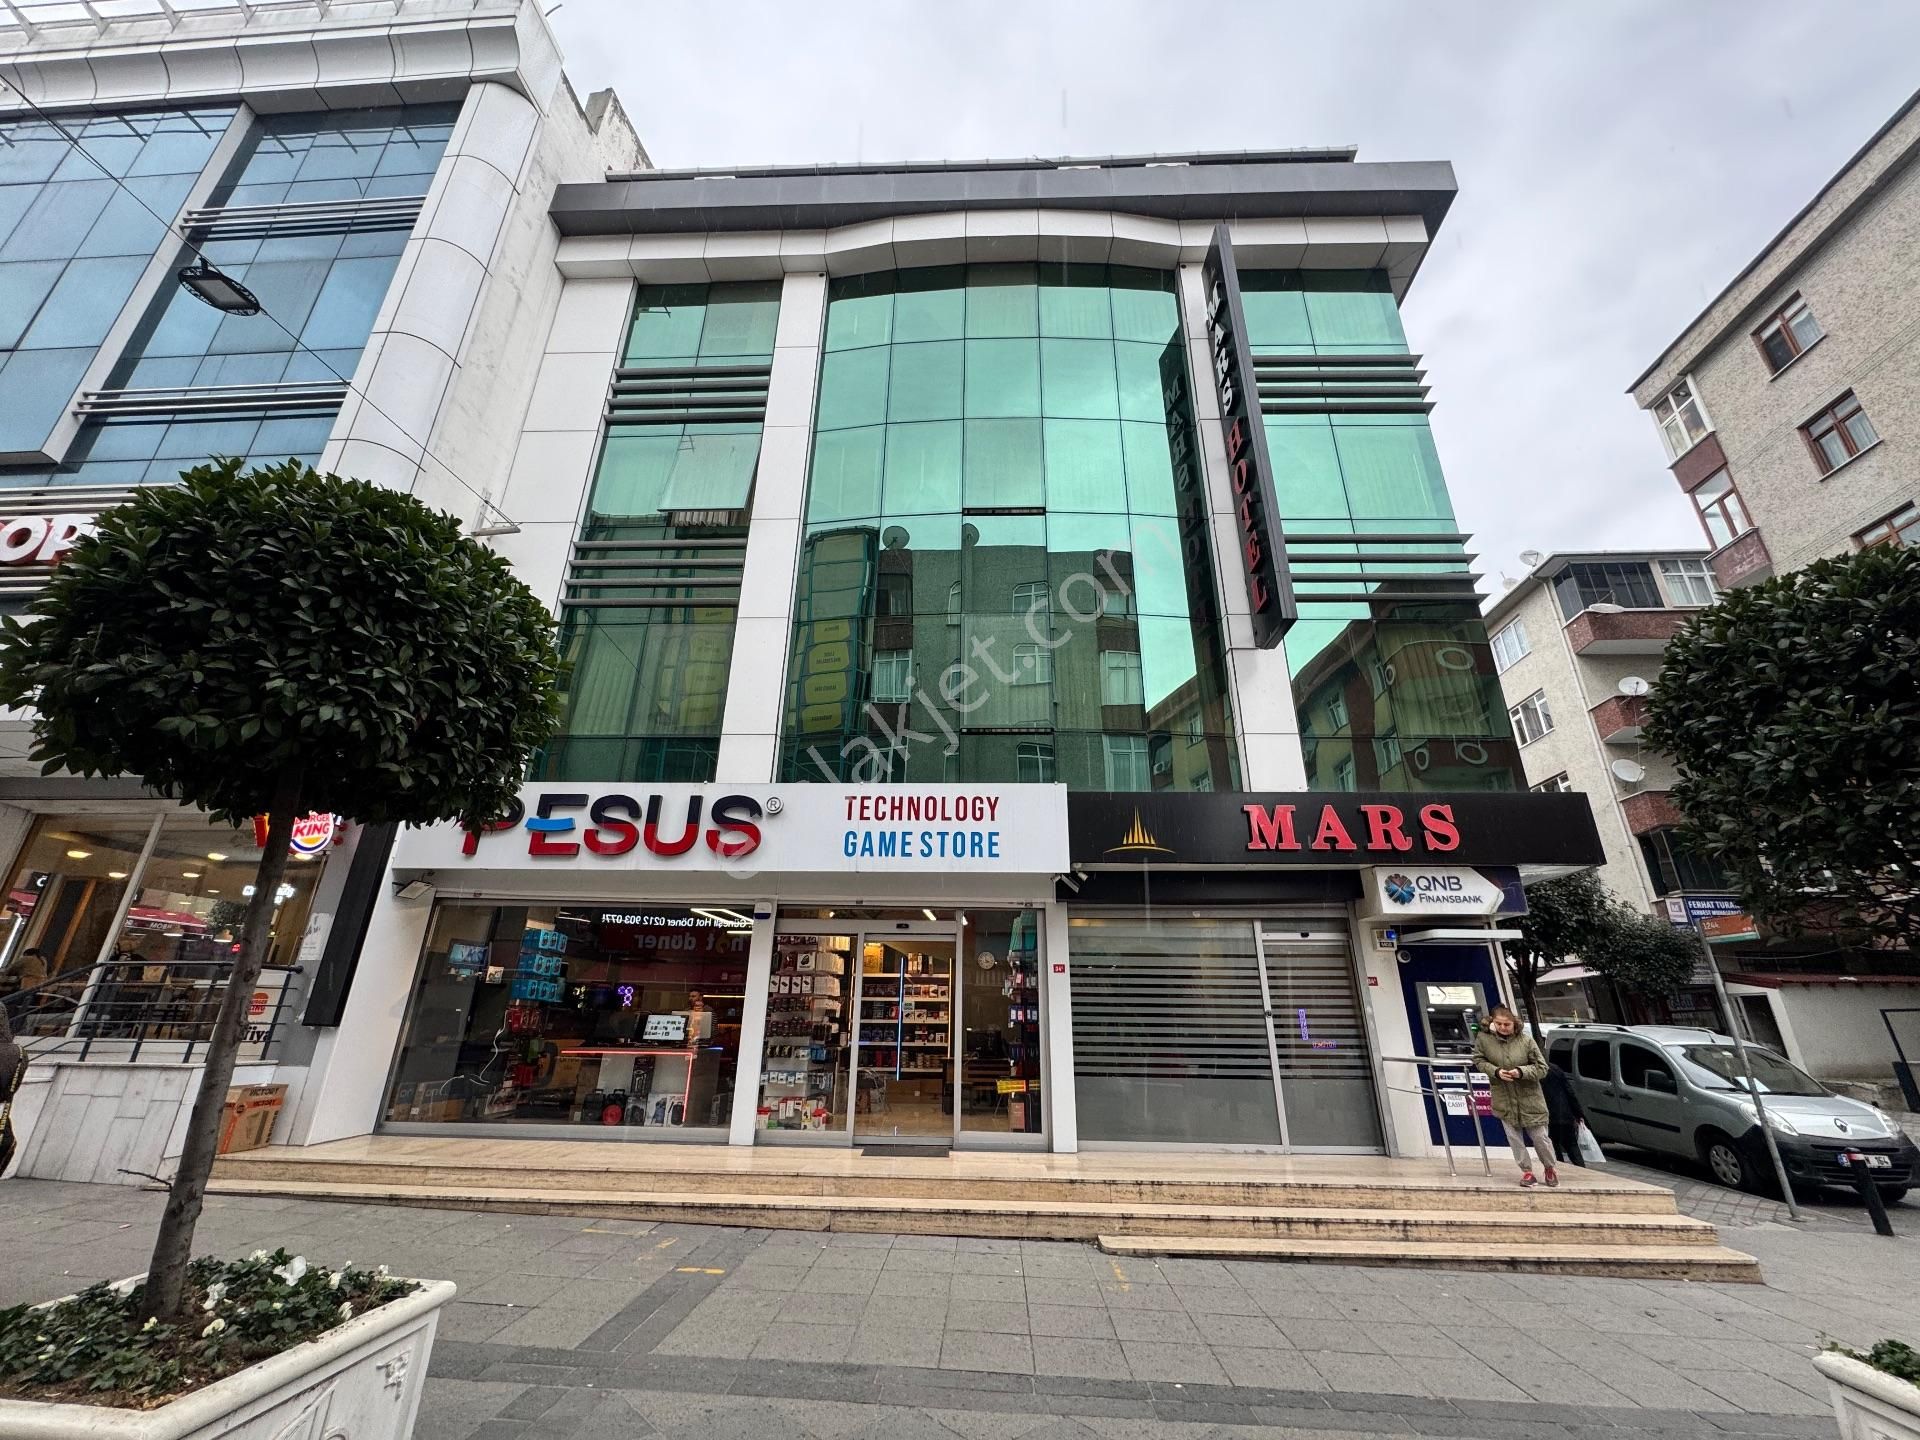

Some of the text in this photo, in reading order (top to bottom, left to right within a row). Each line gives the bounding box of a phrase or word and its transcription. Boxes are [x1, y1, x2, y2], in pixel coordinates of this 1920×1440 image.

[1206, 280, 1234, 416] MARS
[844, 796, 1000, 821] TECHNOLOGY
[293, 822, 331, 838] KING
[460, 793, 763, 857] PESUS
[1243, 804, 1461, 852] MARS
[844, 831, 1000, 858] GAME STORE
[1415, 875, 1463, 891] QNB
[1687, 900, 1715, 909] FERHAT
